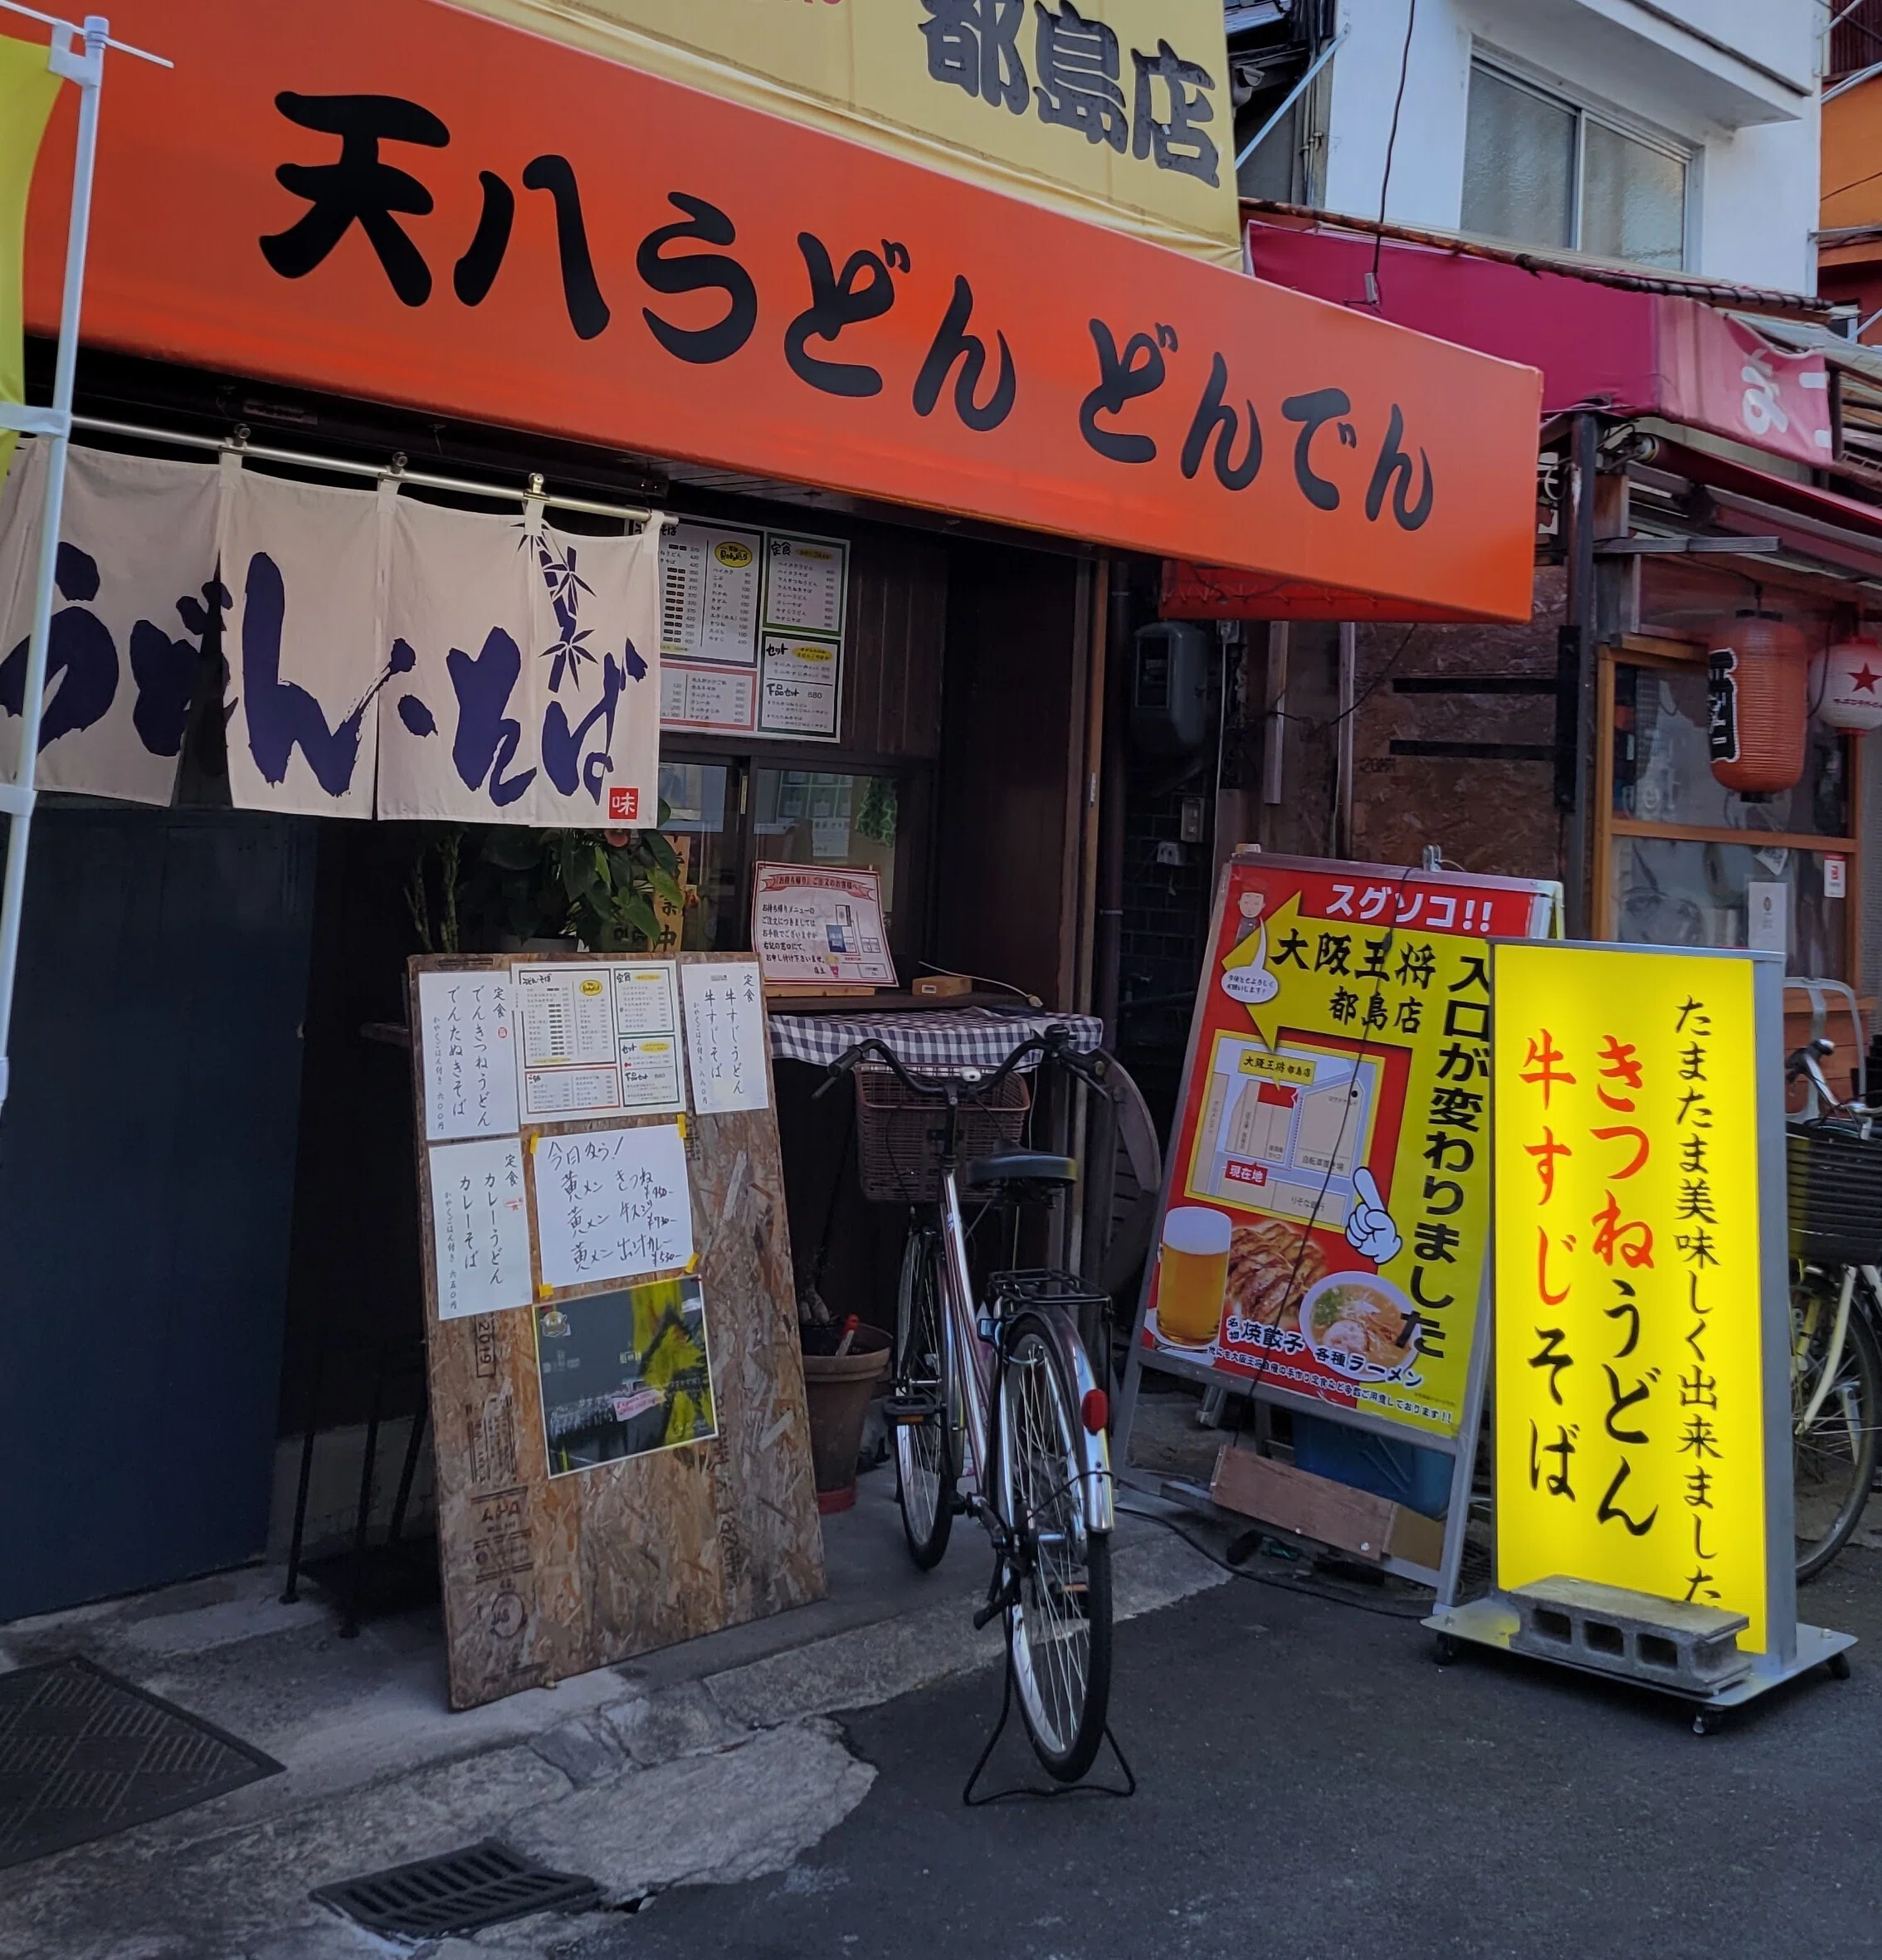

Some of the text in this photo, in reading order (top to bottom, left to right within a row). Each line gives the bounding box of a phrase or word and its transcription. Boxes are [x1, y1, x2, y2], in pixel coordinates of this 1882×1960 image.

[918, 0, 1220, 188] 都島店
[260, 90, 1435, 531] 天八うどん どんでん
[772, 541, 791, 556] 定食
[766, 641, 787, 656] セット
[613, 792, 636, 817] 味
[617, 973, 631, 983] 定食
[1269, 928, 1436, 990] 大阪王将
[493, 987, 506, 1018] 定食
[744, 974, 755, 1002] 定食
[1329, 986, 1424, 1035] 都島店
[447, 986, 466, 1115] でんたぬきそば
[622, 1045, 636, 1054] セット
[705, 989, 722, 1078] 牛すじそば
[724, 988, 744, 1095] 牛すじうどん
[472, 985, 490, 1127] でんきつねうどん
[1244, 1056, 1285, 1072] 大阪王将
[505, 1153, 519, 1187] 定食
[1229, 1164, 1264, 1183] 現在地
[1400, 955, 1490, 1359] 入口が変わりました
[561, 1170, 603, 1202] 黄メン
[616, 1167, 653, 1191] きつね
[460, 1176, 479, 1269] カレーそば
[484, 1173, 503, 1285] カレーうどん
[567, 1205, 610, 1238] 黄メン
[619, 1199, 653, 1223] 牛スジ
[570, 1241, 613, 1272] 黄メン
[1518, 1029, 1581, 1503] 牛すじそば
[1590, 1034, 1660, 1537] きつねうどん
[1674, 994, 1724, 1605] たまたま美味しく出来ました
[1241, 1320, 1304, 1352] 焼餃子
[1314, 1347, 1422, 1387] 各種ラーメン
